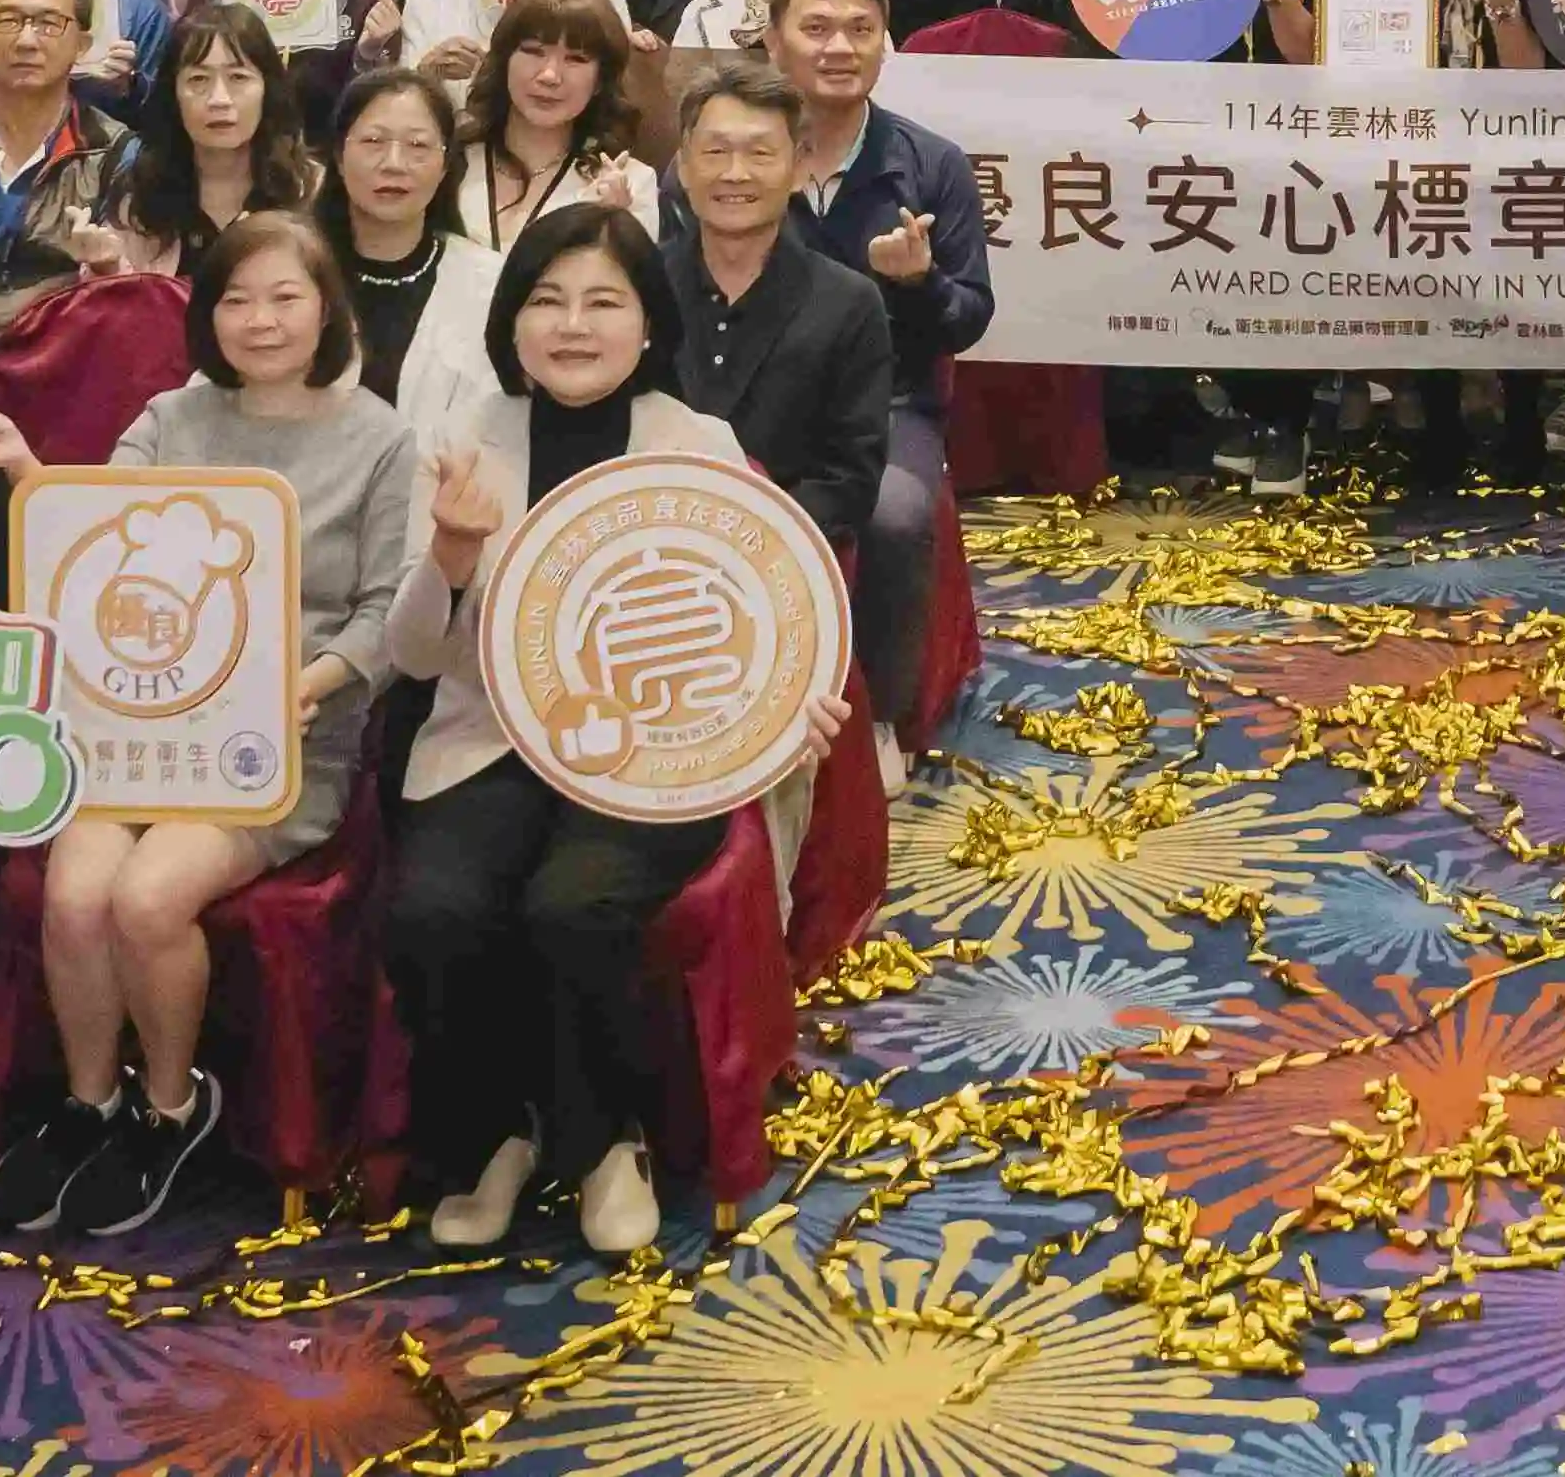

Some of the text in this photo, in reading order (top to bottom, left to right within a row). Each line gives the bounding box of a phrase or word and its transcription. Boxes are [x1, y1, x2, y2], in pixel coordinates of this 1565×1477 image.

[1225, 101, 1438, 140] 114年雲林縣
[1171, 268, 1290, 296] AWARD
[1302, 271, 1482, 299] CEREMONY
[1495, 274, 1524, 298] IN
[529, 602, 559, 702] YUNLIN
[104, 665, 184, 700] GHP
